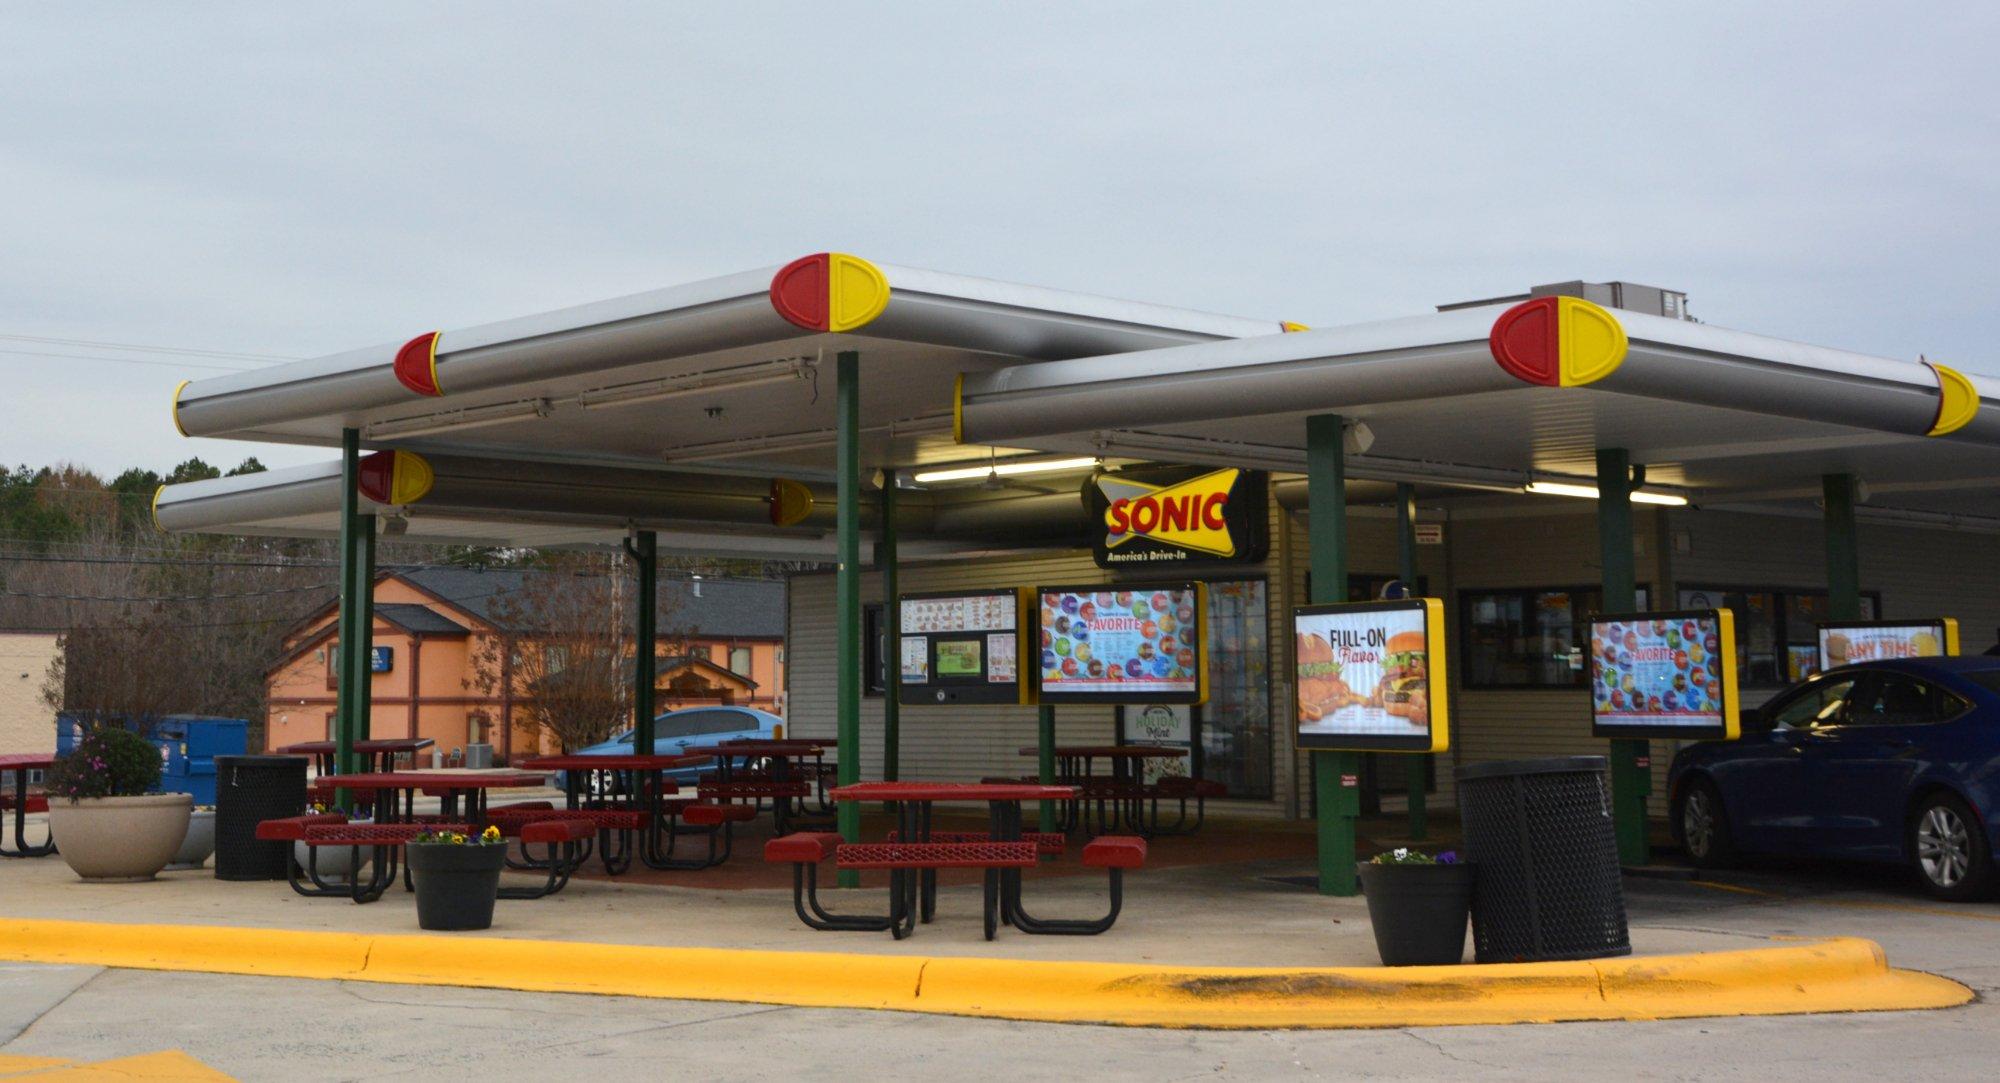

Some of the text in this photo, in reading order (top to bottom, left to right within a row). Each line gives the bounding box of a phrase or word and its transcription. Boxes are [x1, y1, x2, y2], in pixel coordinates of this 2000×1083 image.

[1109, 492, 1230, 534] SONIC
[1107, 549, 1187, 562] America's Drive-In
[1087, 617, 1142, 631] FAVORITE
[1330, 627, 1386, 648] FULL-ON
[1339, 646, 1380, 665] Flavor
[1845, 639, 1918, 658] ANY TIME
[1135, 715, 1180, 729] HOLIDAY
